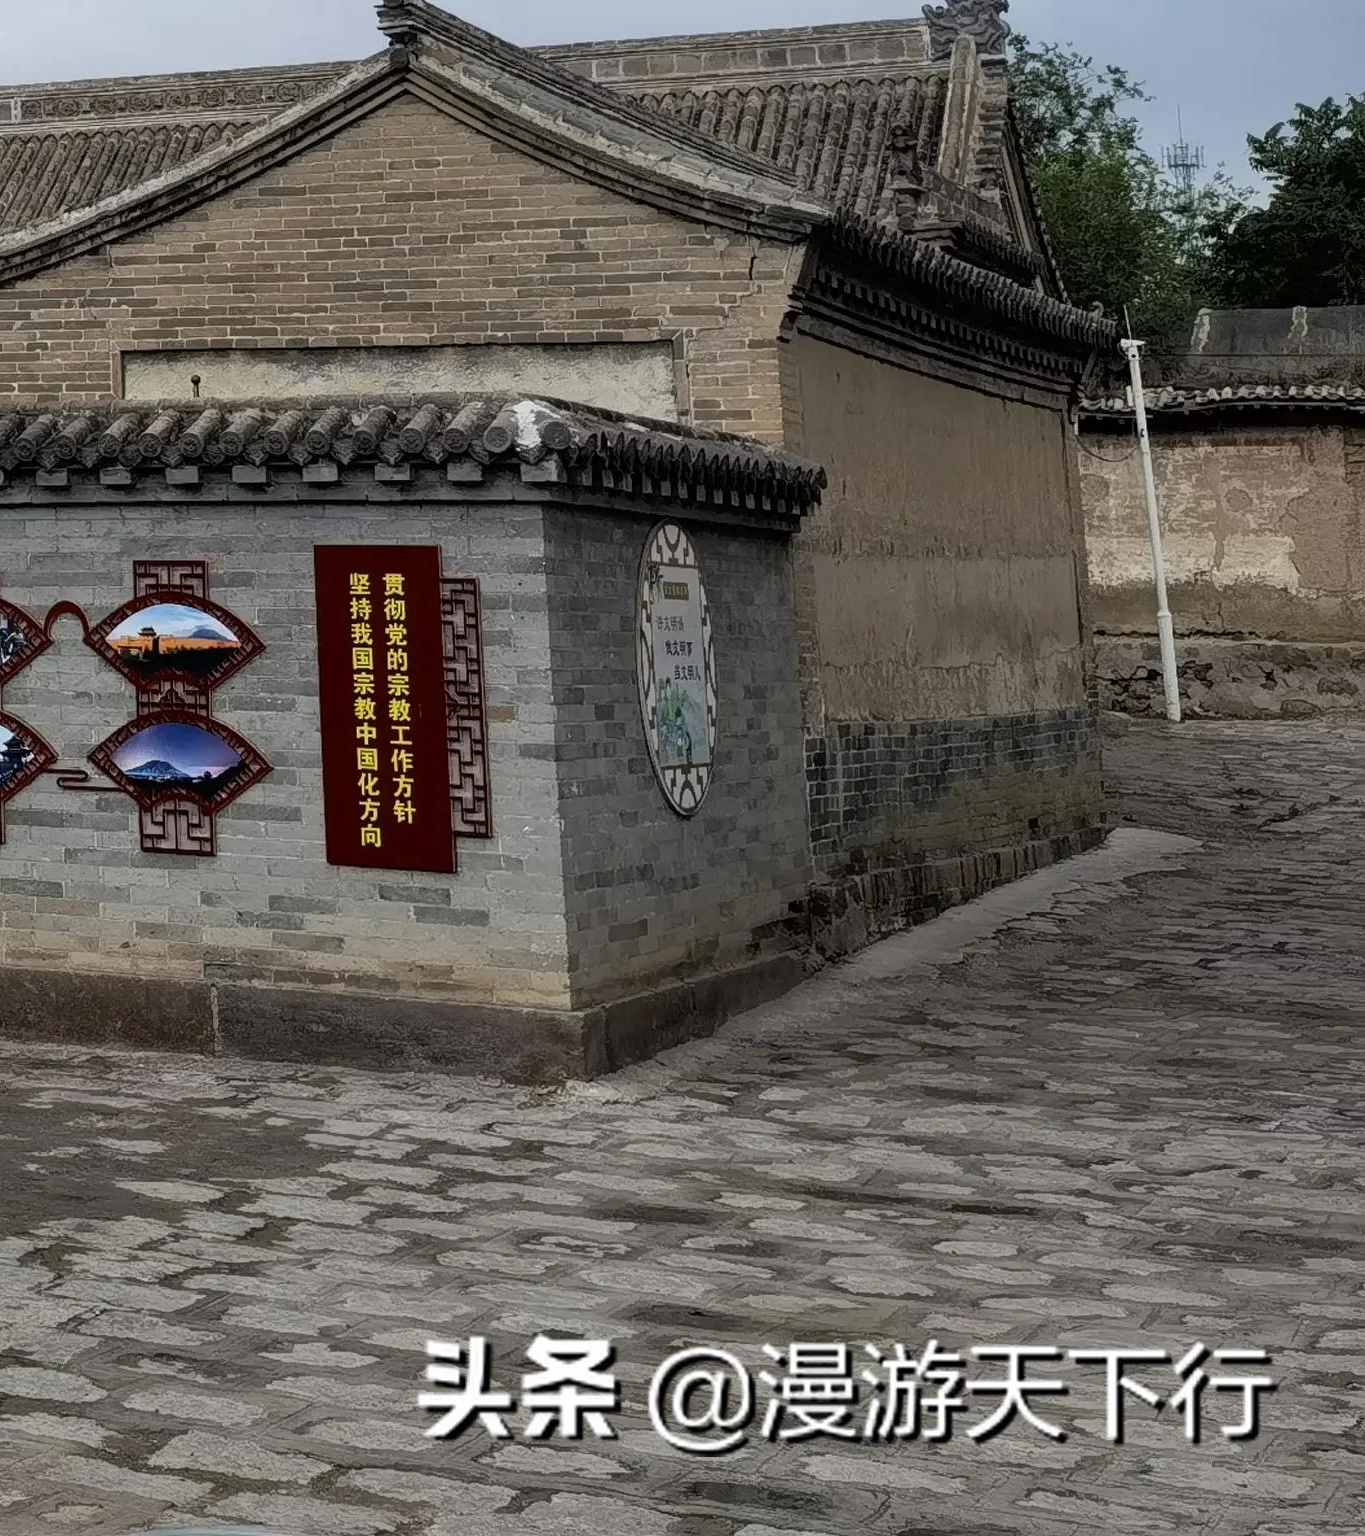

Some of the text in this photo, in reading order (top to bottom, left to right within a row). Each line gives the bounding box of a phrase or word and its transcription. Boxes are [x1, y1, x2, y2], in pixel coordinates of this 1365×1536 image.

[350, 572, 381, 847] 坚持我国宗教中国化方向
[382, 573, 416, 824] 贯彻党的宗教工作方针
